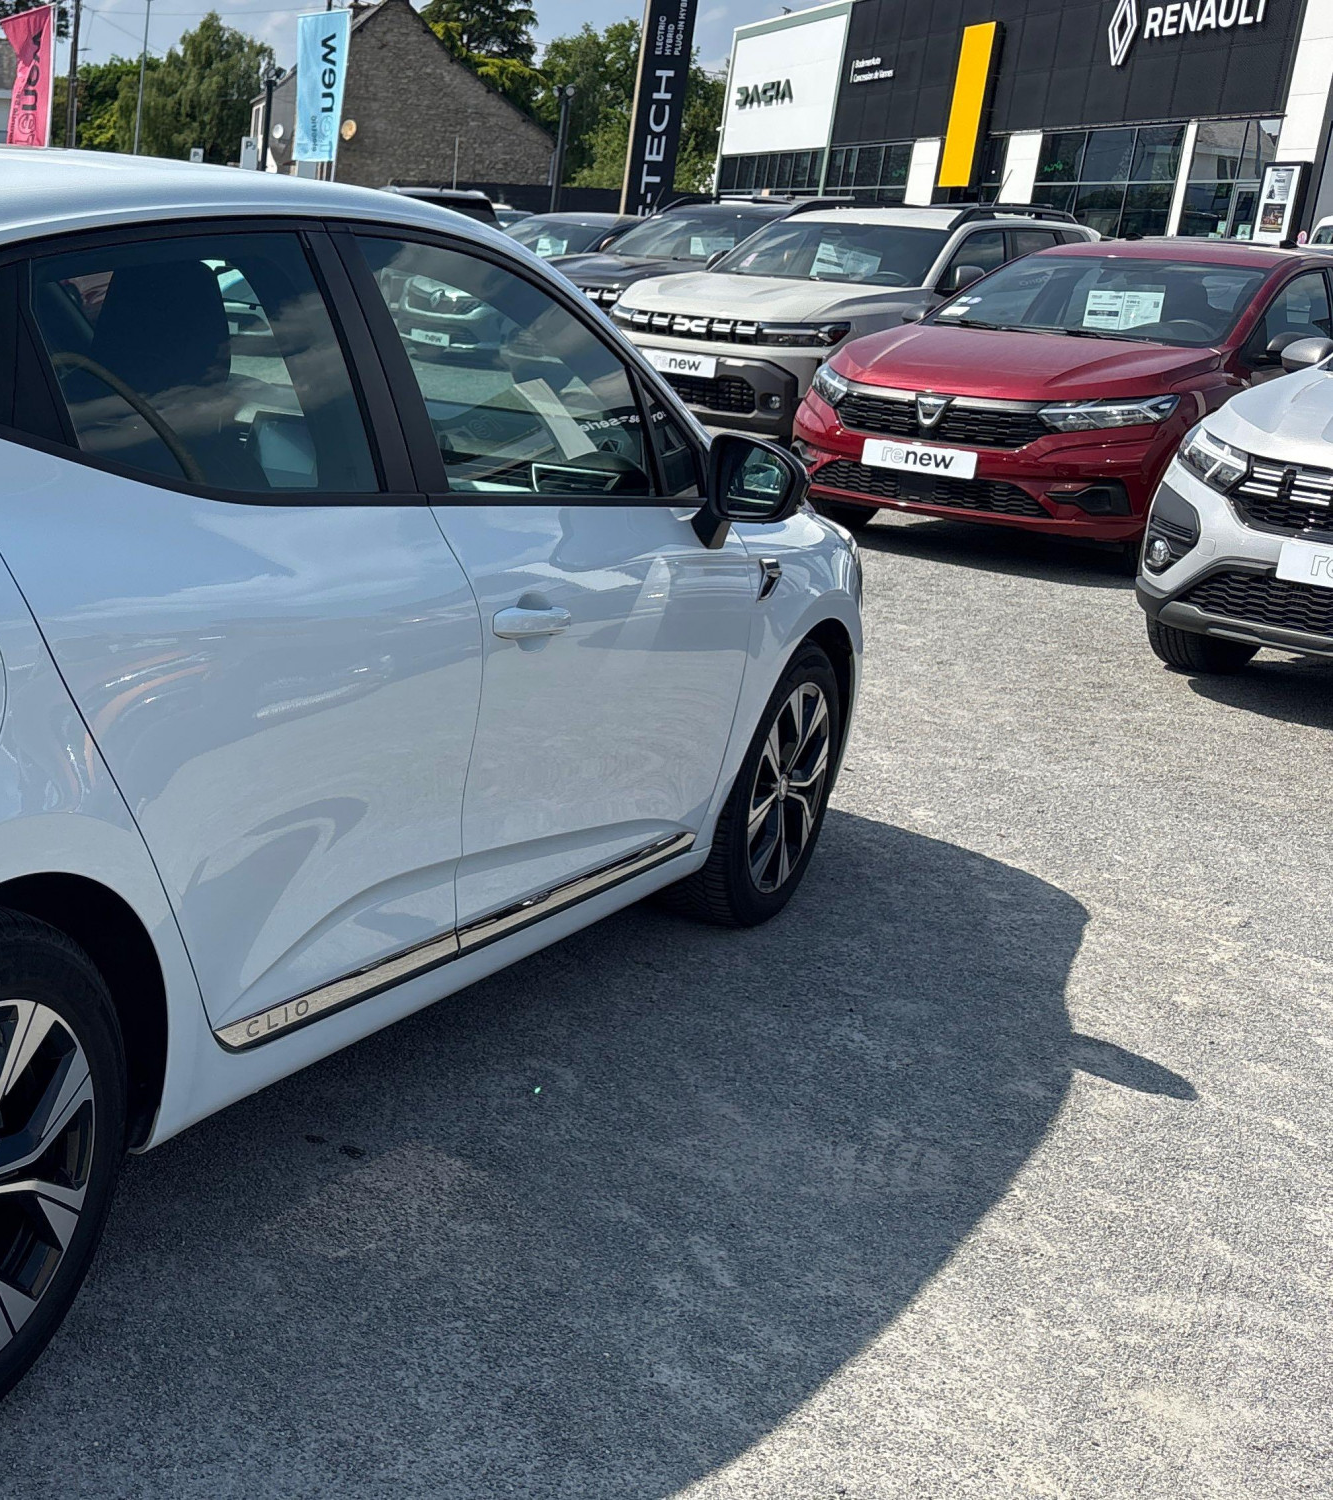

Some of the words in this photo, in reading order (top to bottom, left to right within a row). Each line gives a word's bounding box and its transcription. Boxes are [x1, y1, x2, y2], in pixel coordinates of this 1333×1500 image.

[654, 15, 667, 55] ELECTRIC
[673, 21, 685, 56] PLUG-IN
[679, 0, 688, 19] HYB
[1144, 0, 1266, 39] RENAULT
[664, 23, 675, 56] HYBRID
[653, 354, 701, 372] renew
[881, 446, 954, 470] renew
[247, 999, 309, 1038] CLIO
